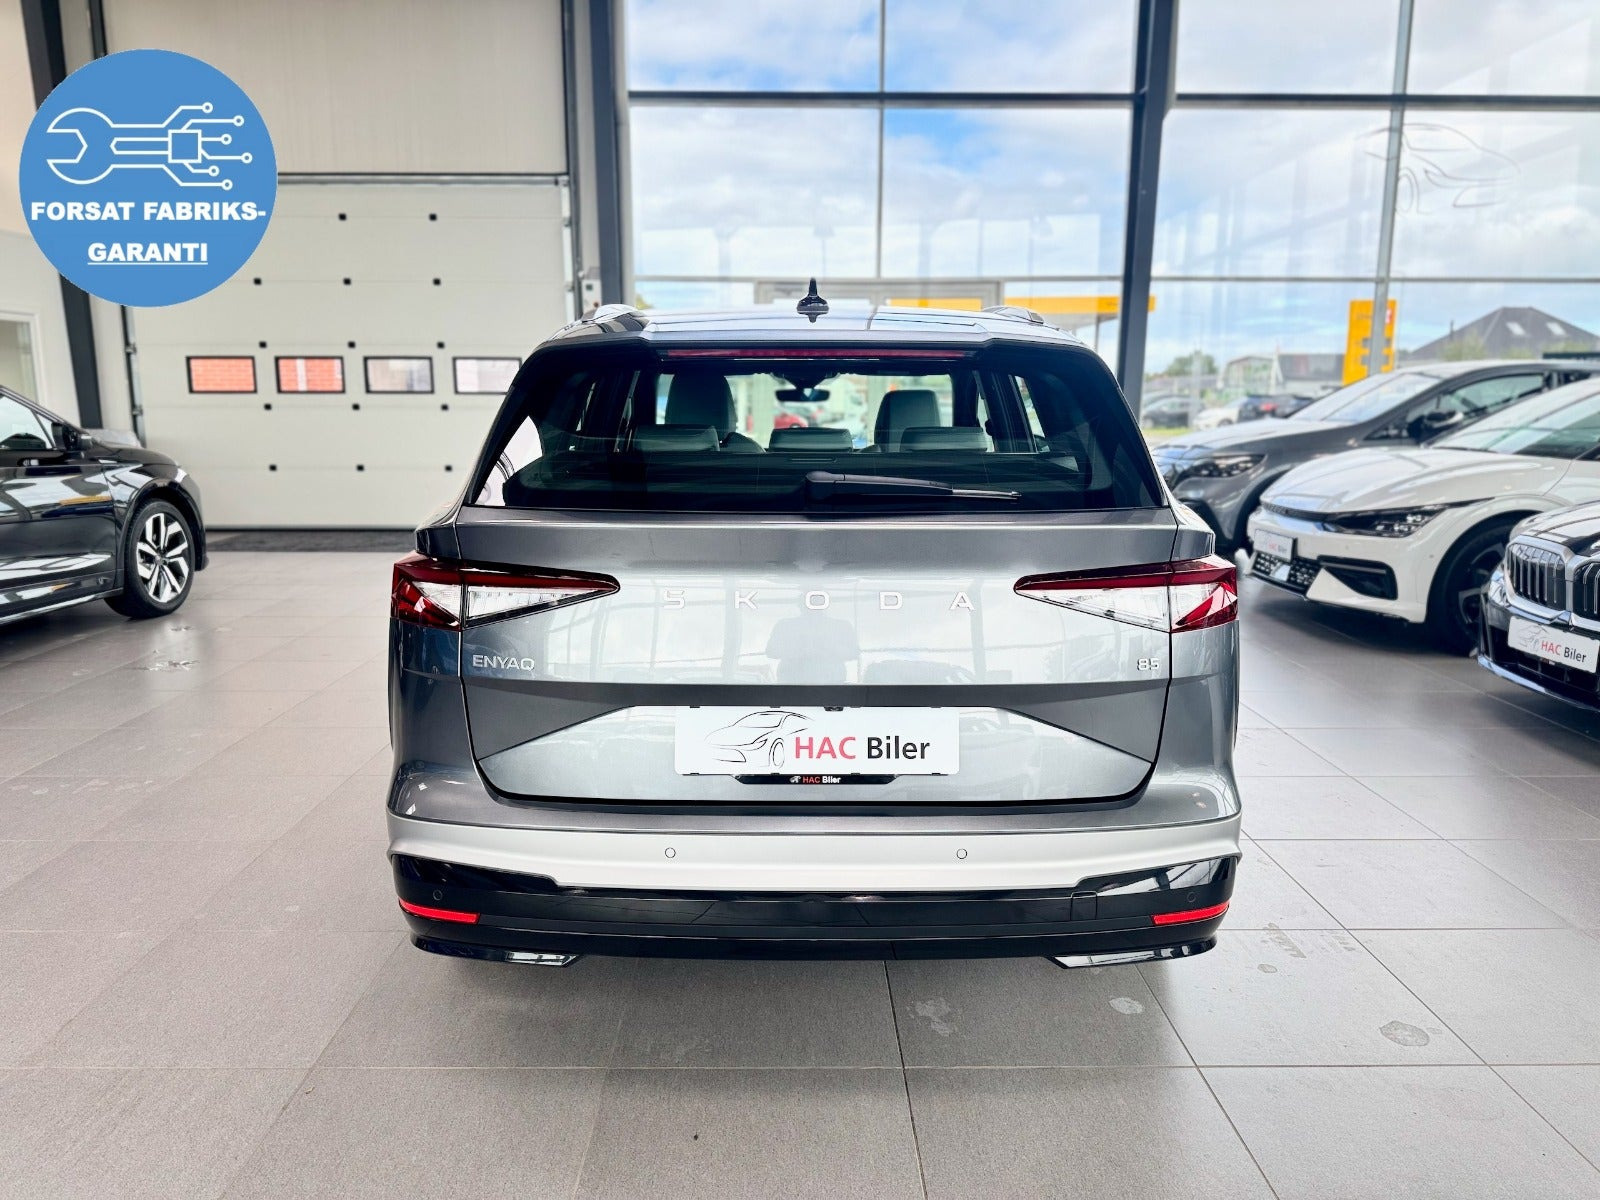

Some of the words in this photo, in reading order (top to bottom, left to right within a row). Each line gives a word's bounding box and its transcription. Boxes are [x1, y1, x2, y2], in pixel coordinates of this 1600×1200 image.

[1541, 640, 1561, 656] HAC
[1563, 646, 1587, 663] Biler
[472, 654, 535, 671] ENYAQ
[1137, 657, 1160, 671] 85
[795, 736, 856, 759] HAC
[867, 735, 930, 759] Biler
[802, 776, 821, 784] HAC
[822, 775, 841, 784] Biler
